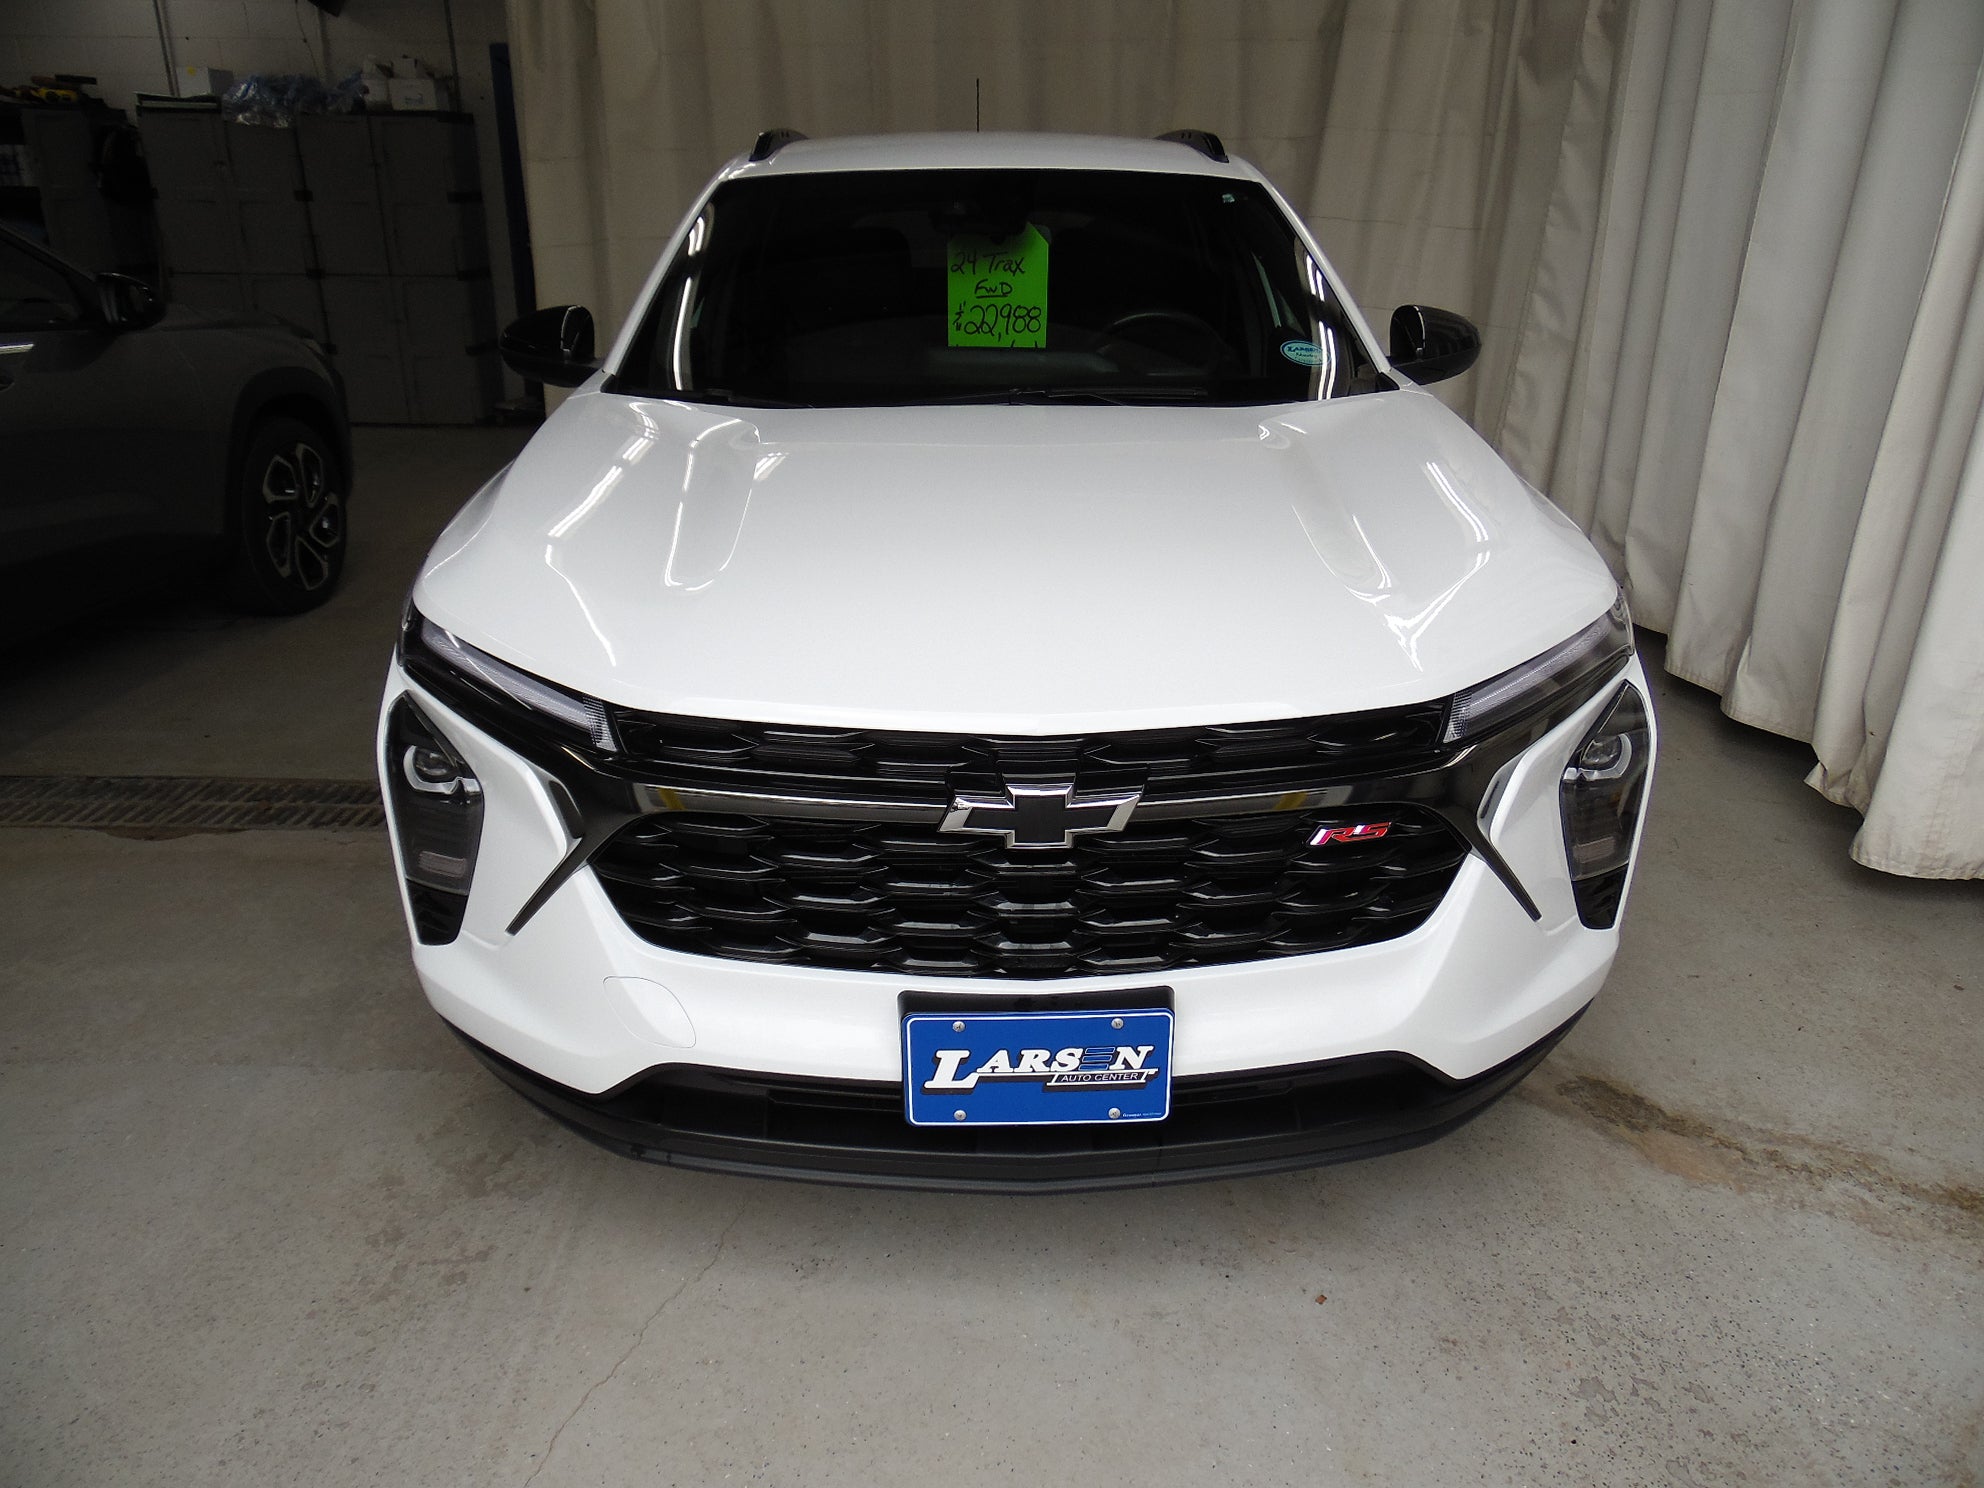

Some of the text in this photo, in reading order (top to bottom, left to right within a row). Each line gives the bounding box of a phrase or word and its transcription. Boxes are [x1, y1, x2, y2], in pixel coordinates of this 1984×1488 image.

[950, 250, 1025, 276] 24 Trax
[1308, 821, 1392, 845] RS
[923, 1045, 1156, 1089] LARSEN
[1060, 1072, 1139, 1083] AUTO CENTER
